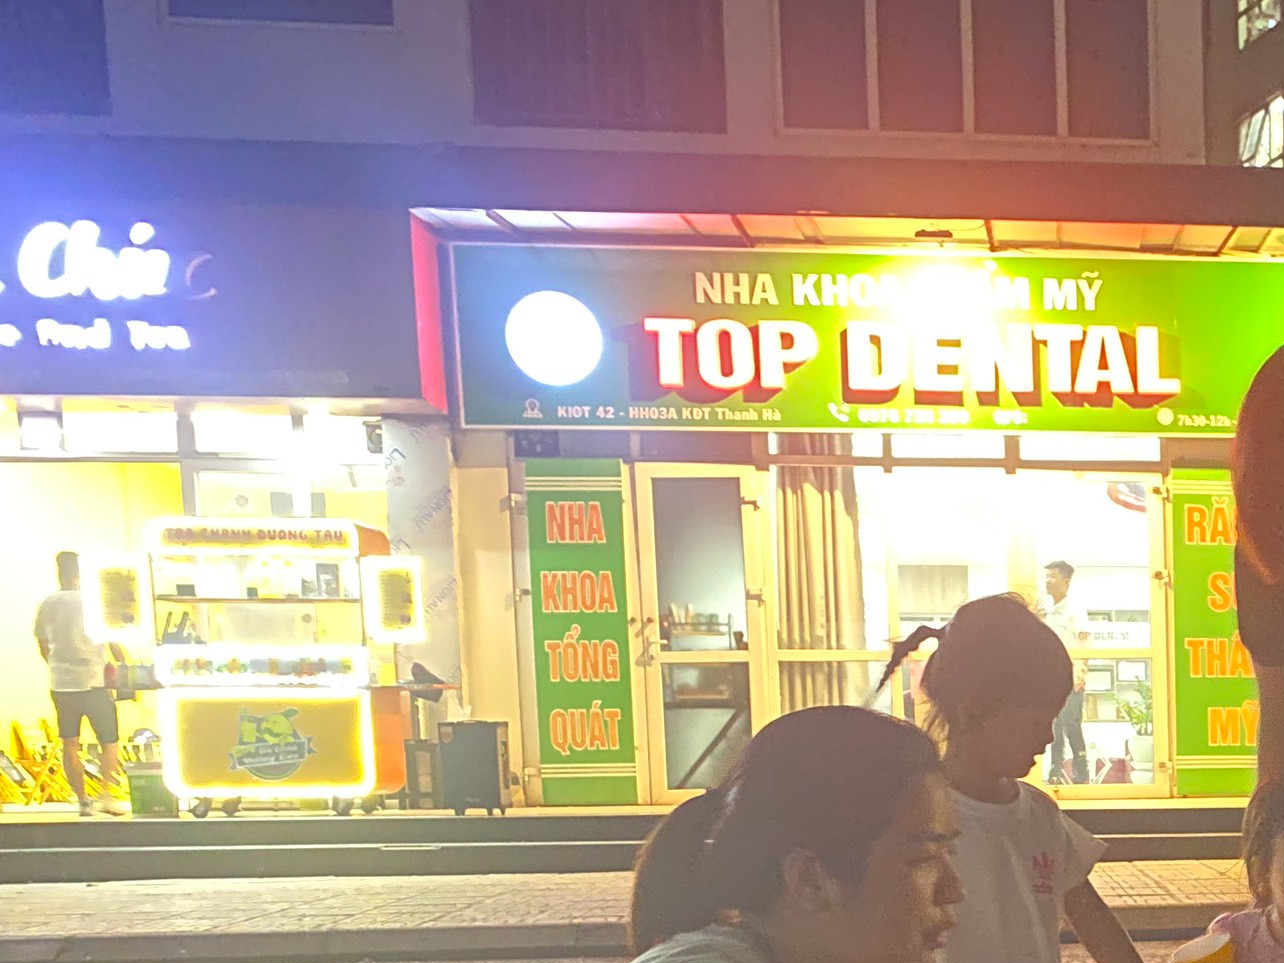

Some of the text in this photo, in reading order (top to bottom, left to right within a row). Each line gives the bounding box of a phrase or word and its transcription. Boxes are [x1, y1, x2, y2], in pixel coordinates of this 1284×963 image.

[694, 272, 779, 306] NHA
[1042, 271, 1103, 312] MỸ
[643, 316, 1181, 395] TOP DENTAL
[557, 406, 591, 419] KIOT
[596, 406, 614, 419] 42
[682, 407, 711, 420] KĐT
[715, 407, 759, 421] Thanh
[762, 408, 781, 422] Hà
[546, 501, 606, 544] NHA
[540, 571, 617, 613] KHOA
[545, 624, 620, 682] TỔNG
[549, 700, 622, 756] QUÁT
